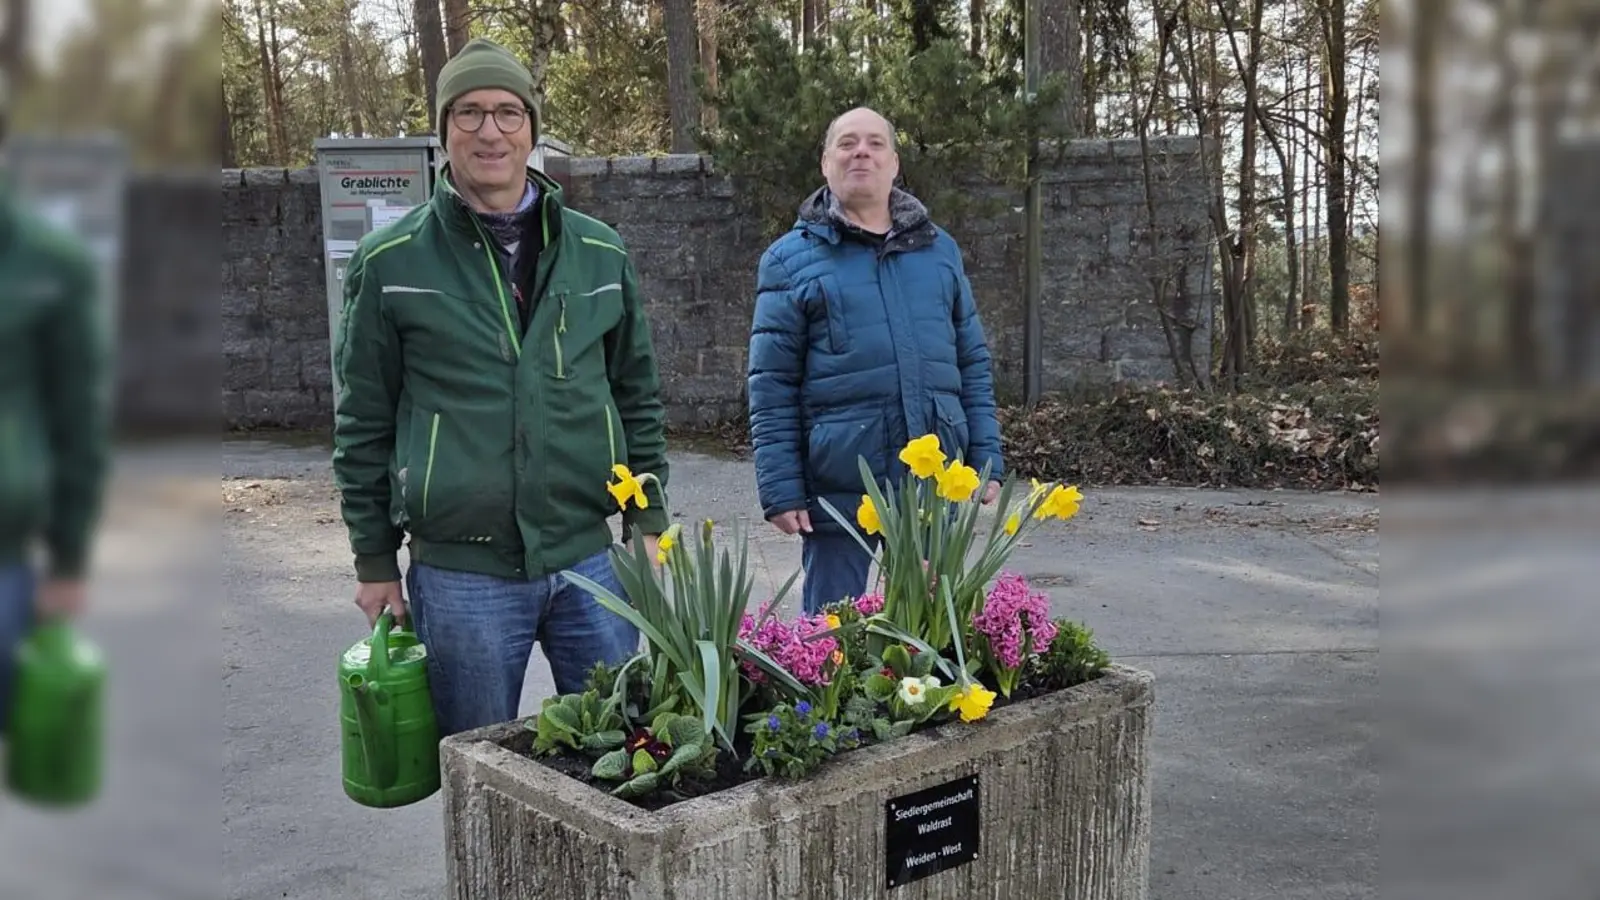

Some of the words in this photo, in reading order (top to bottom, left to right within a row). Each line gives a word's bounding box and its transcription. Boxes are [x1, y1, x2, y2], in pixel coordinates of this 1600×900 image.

[341, 177, 409, 188] Grablichte
[895, 788, 973, 821] Siedlergemeinschaft
[917, 816, 952, 835] Waldrast
[906, 851, 937, 868] Weiden
[942, 842, 962, 857] West
